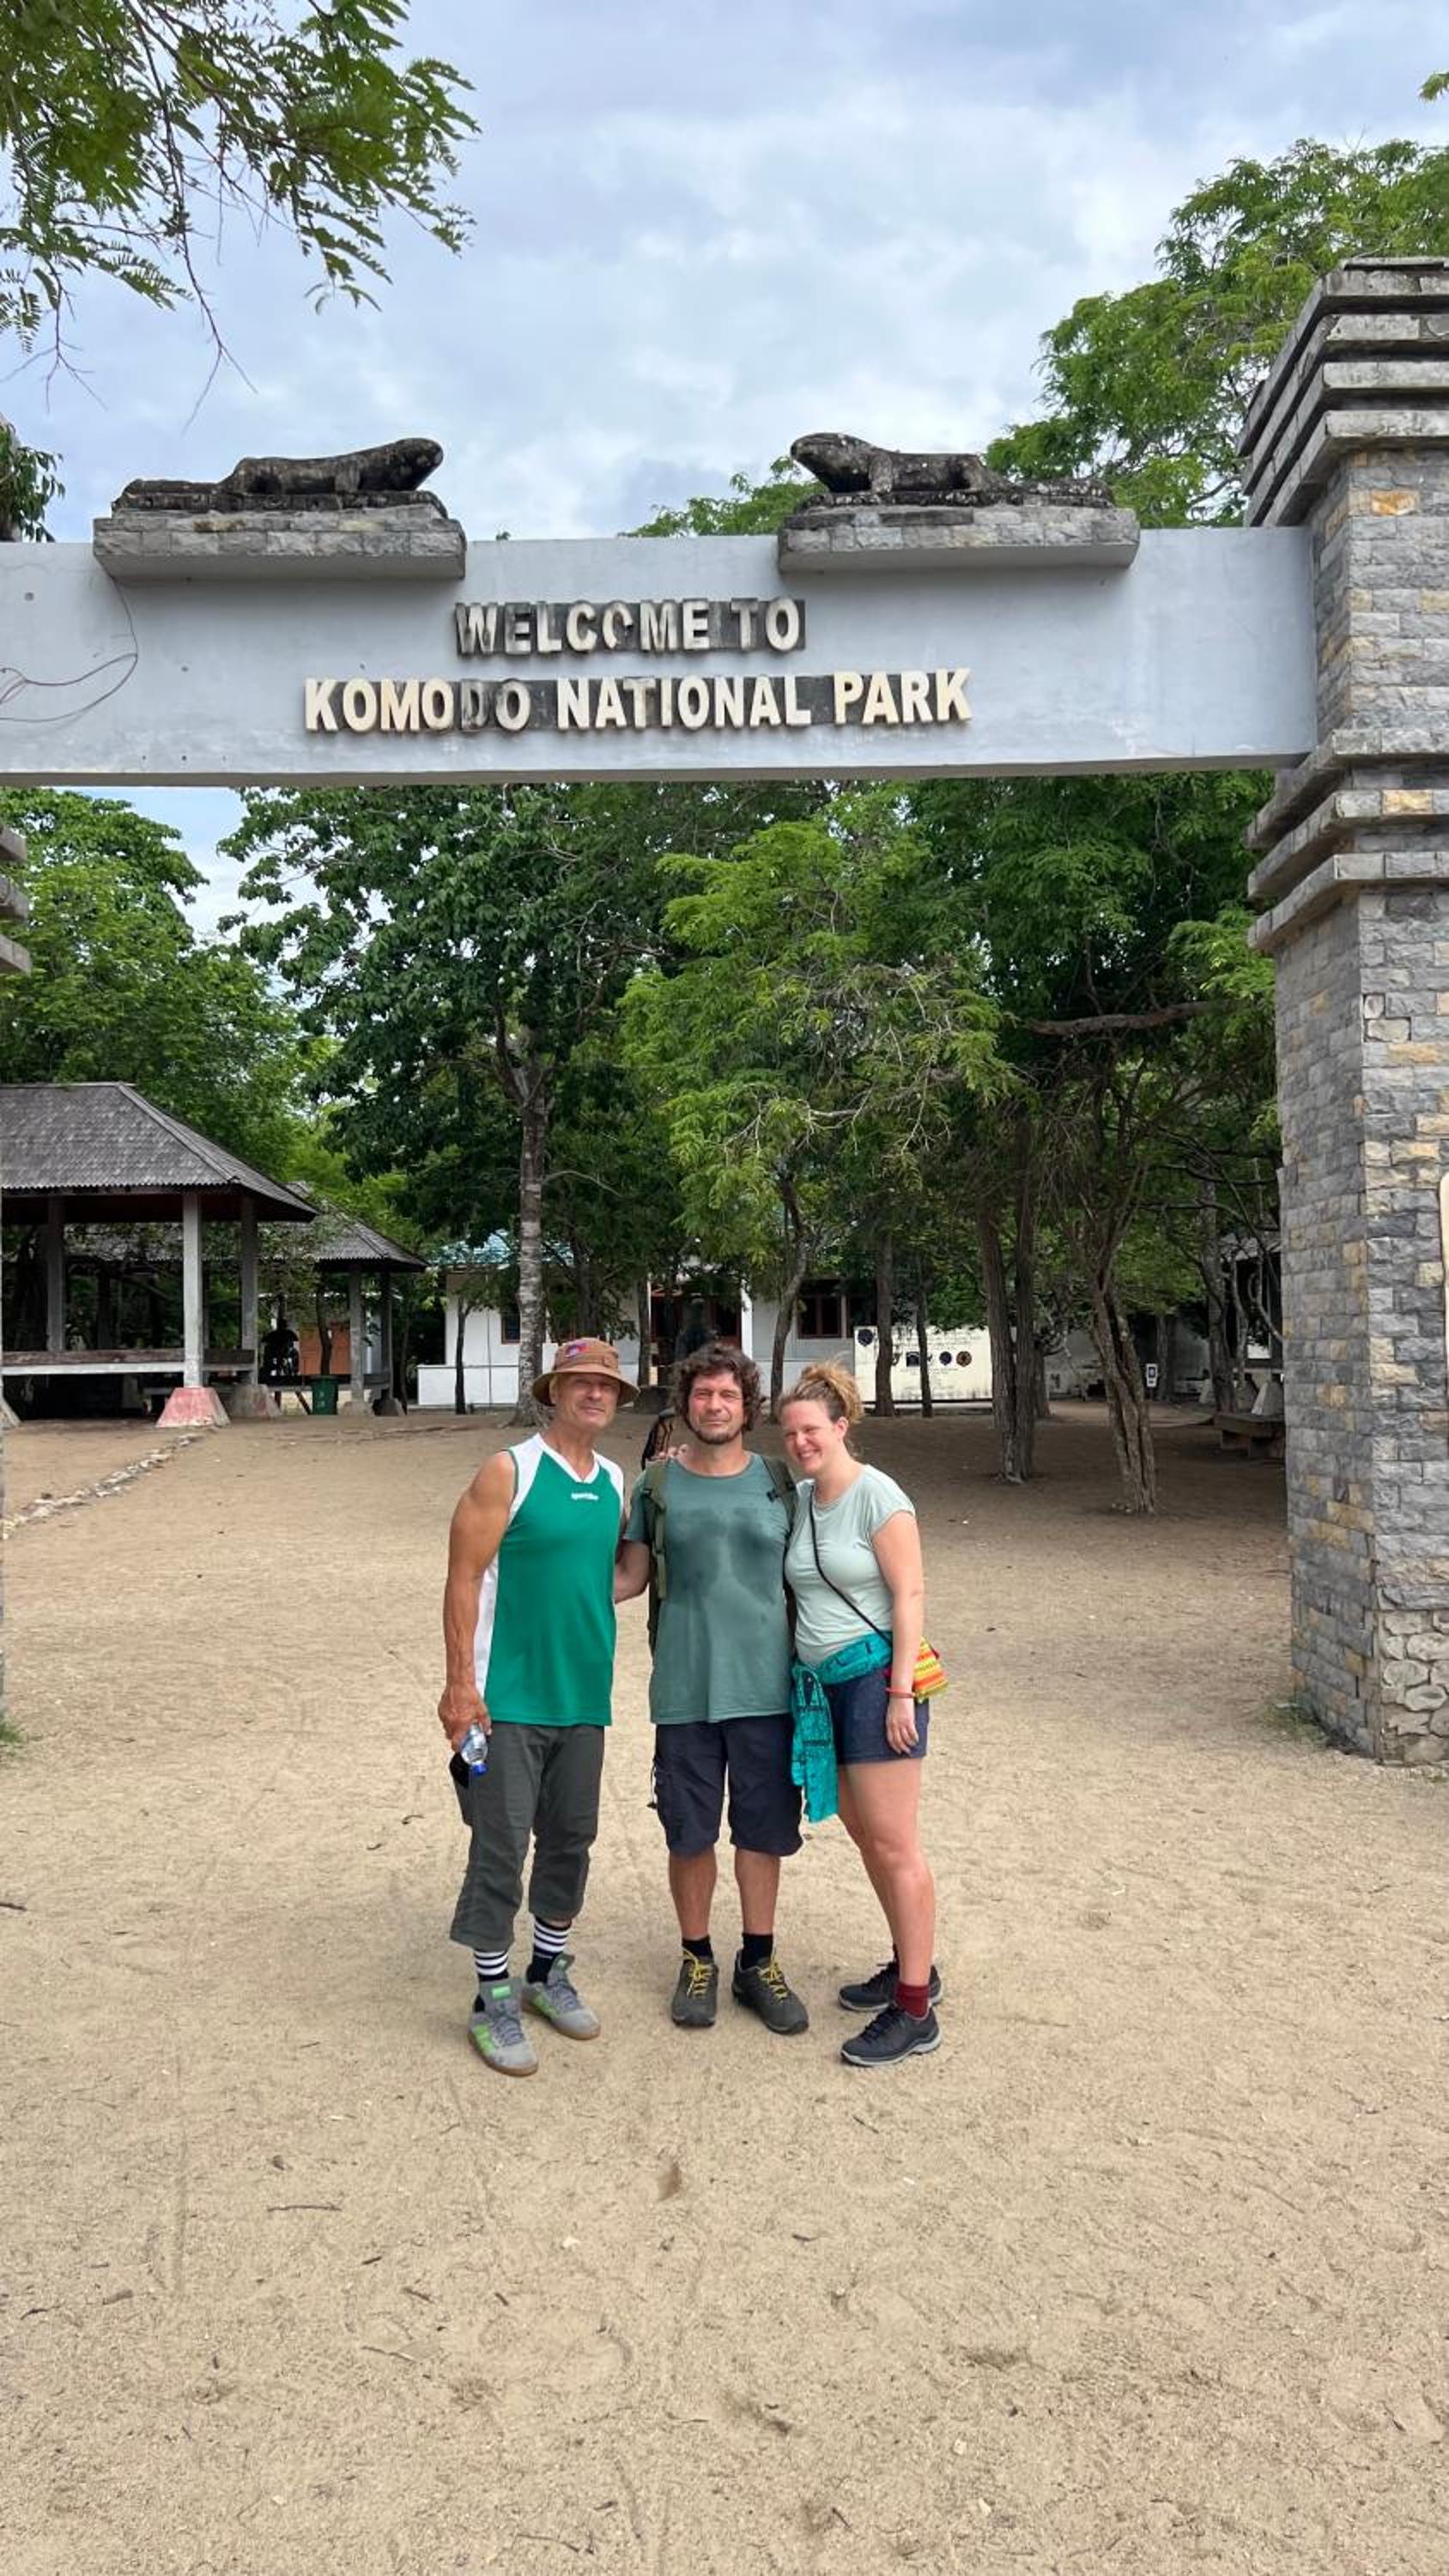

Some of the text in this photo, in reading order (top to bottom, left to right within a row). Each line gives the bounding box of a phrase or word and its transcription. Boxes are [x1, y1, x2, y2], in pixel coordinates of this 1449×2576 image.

[456, 598, 800, 653] WELCOME TO
[305, 667, 974, 732] KOMODO NATIONAL PARK
